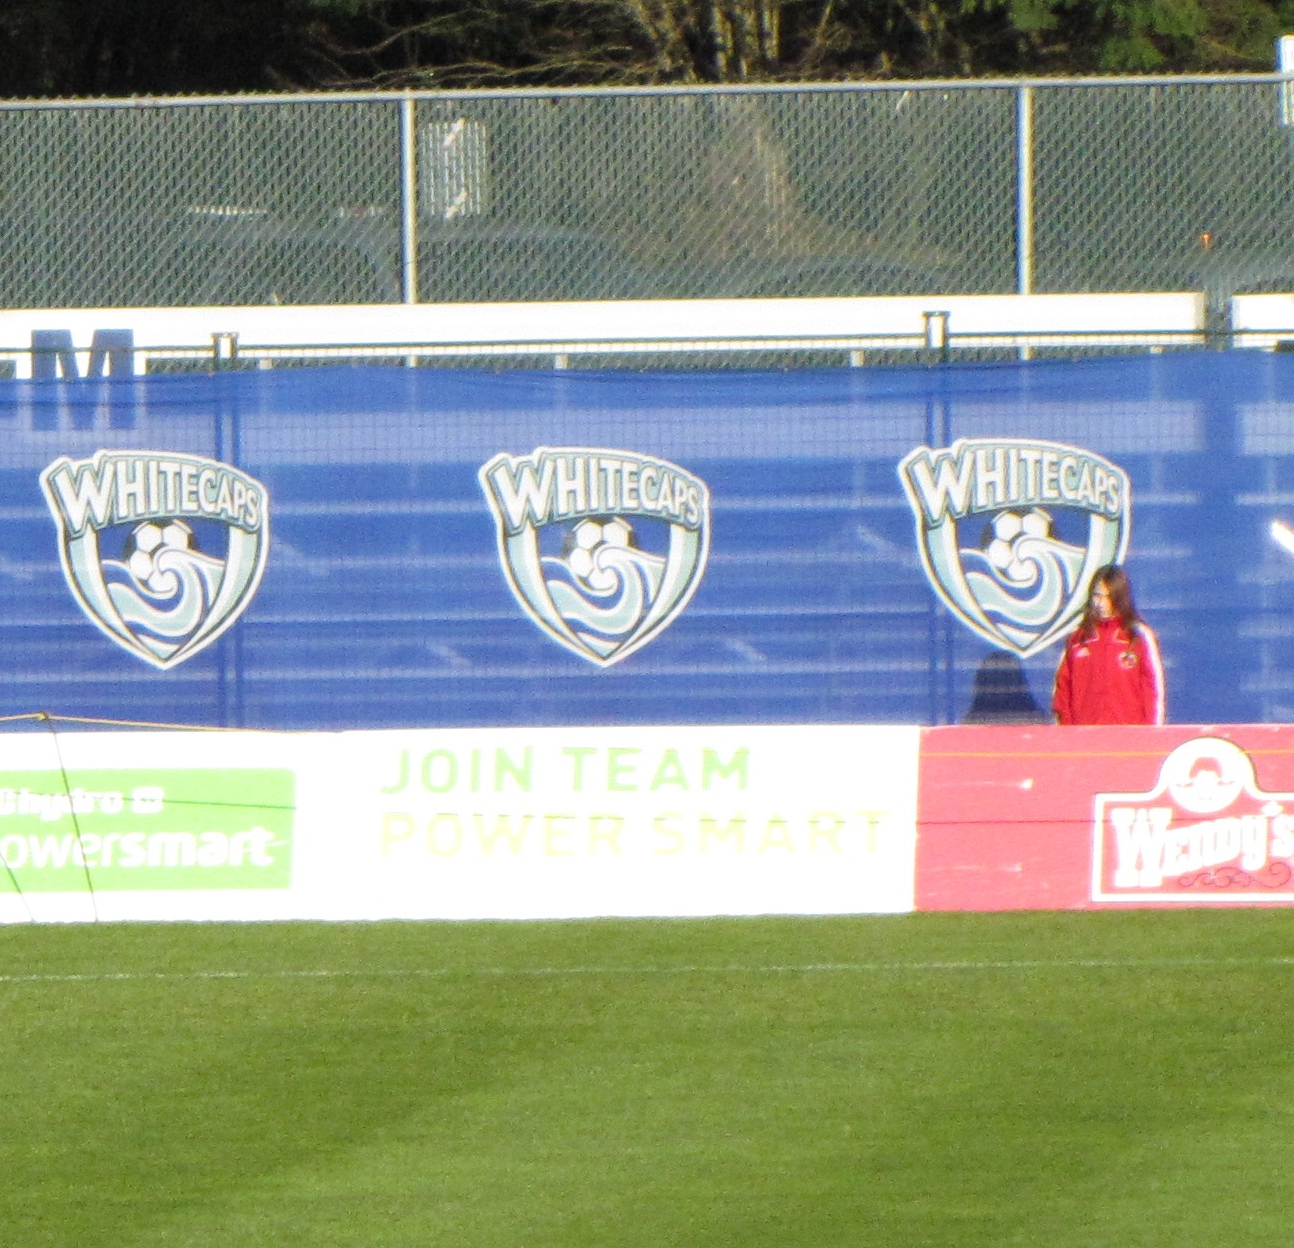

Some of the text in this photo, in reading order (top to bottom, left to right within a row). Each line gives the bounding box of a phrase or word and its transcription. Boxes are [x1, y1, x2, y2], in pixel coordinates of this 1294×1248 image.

[31, 329, 135, 430] M
[53, 456, 260, 532] WHITECAPS
[492, 452, 699, 532] WHITECAPS
[912, 446, 1121, 522] WHITECAPS
[379, 744, 751, 794] JOIN TEAM
[378, 807, 890, 858] POWER SMART
